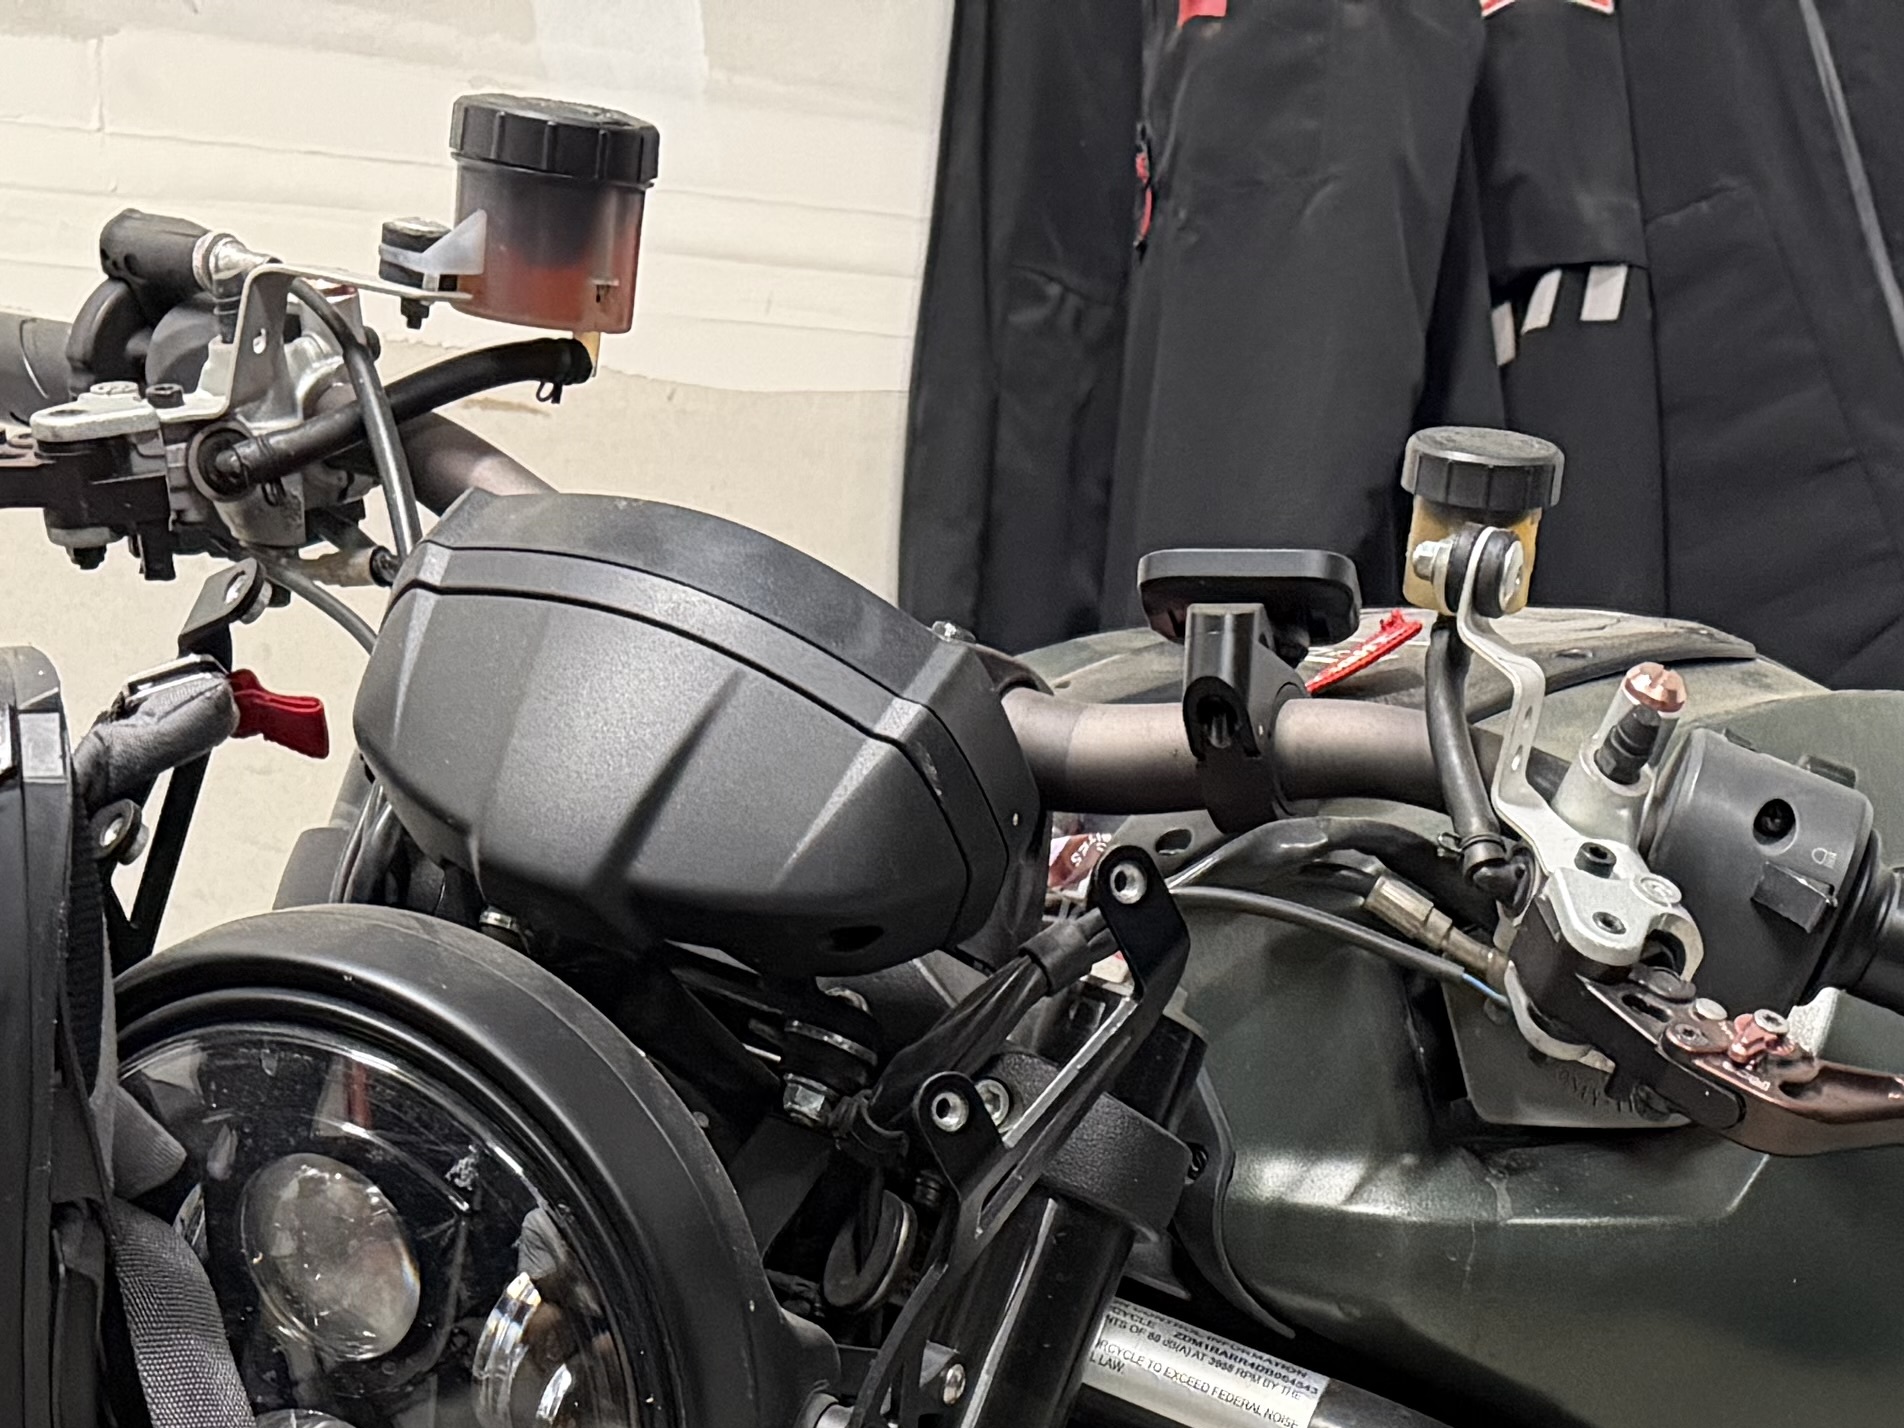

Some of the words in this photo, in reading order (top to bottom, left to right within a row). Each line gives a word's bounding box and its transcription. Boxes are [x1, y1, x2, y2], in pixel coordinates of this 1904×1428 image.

[1111, 1306, 1155, 1328] CYCLE
[1129, 1324, 1145, 1336] OF
[1192, 1350, 1206, 1361] AT
[1207, 1334, 1307, 1378] INFORMATION
[1147, 1360, 1162, 1373] TO
[1163, 1367, 1209, 1392] EXCEED
[1212, 1387, 1263, 1414] FEDERAL
